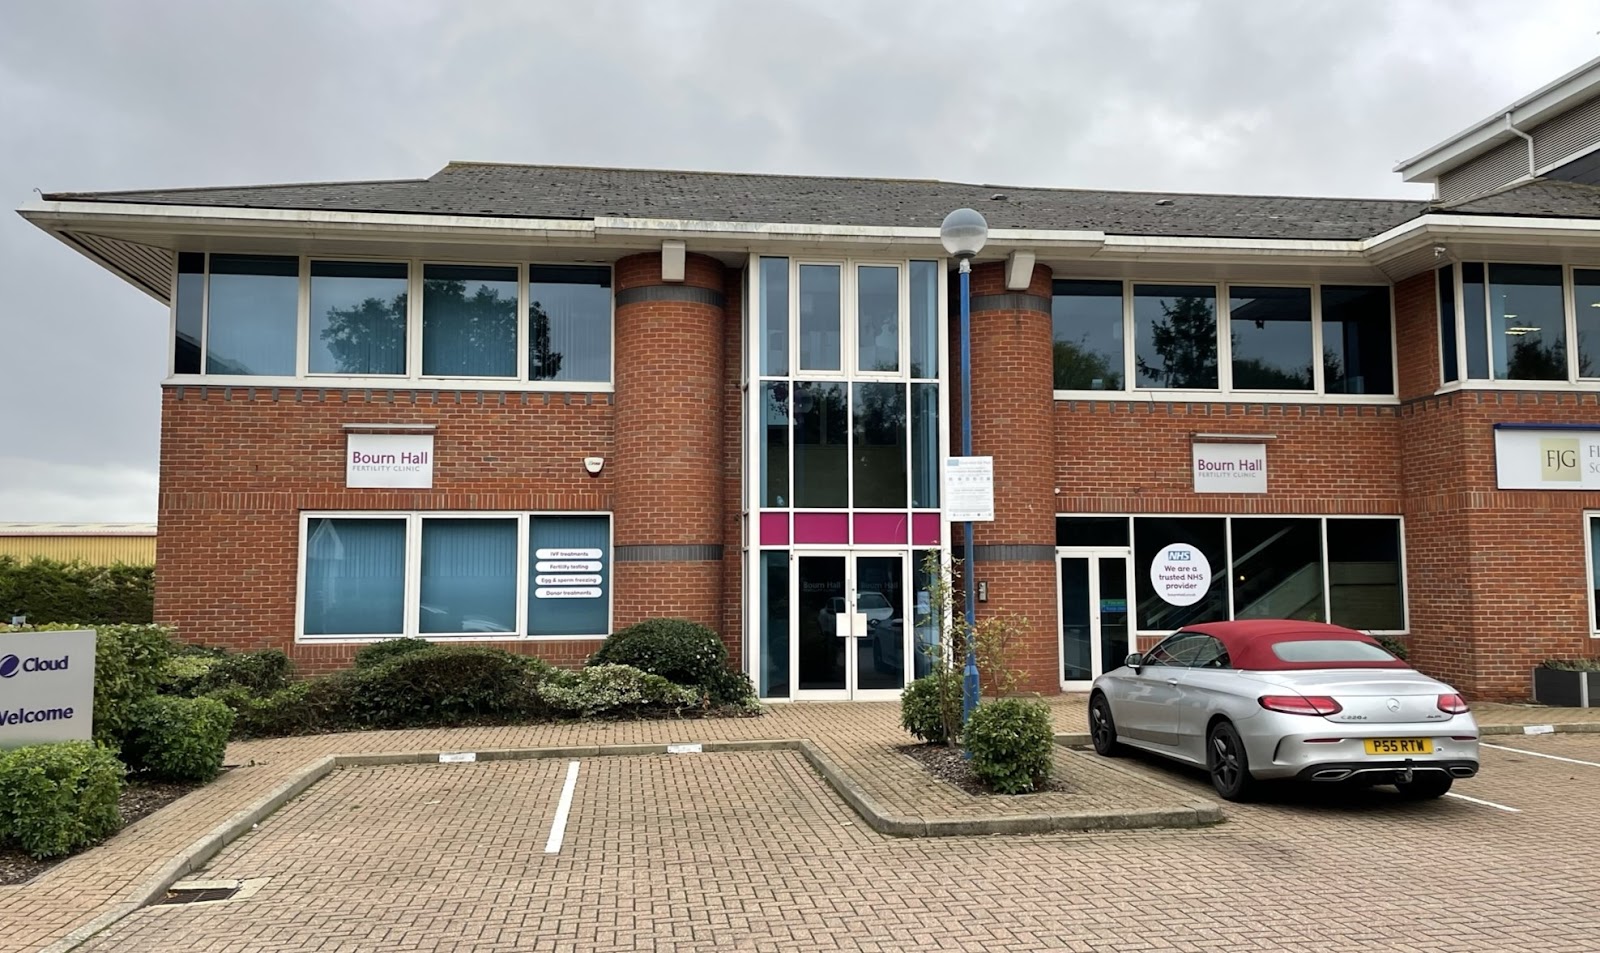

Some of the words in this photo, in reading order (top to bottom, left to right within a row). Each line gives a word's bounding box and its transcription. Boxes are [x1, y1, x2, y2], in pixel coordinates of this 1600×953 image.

[352, 451, 395, 464] Bourn
[401, 452, 428, 464] Hall
[1547, 450, 1576, 472] FJG
[1198, 459, 1235, 471] Bourn
[1239, 459, 1262, 471] Hall
[1168, 552, 1190, 560] NHS
[22, 655, 69, 672] Cloud
[1374, 740, 1398, 752] P55
[1401, 740, 1424, 752] RTW
